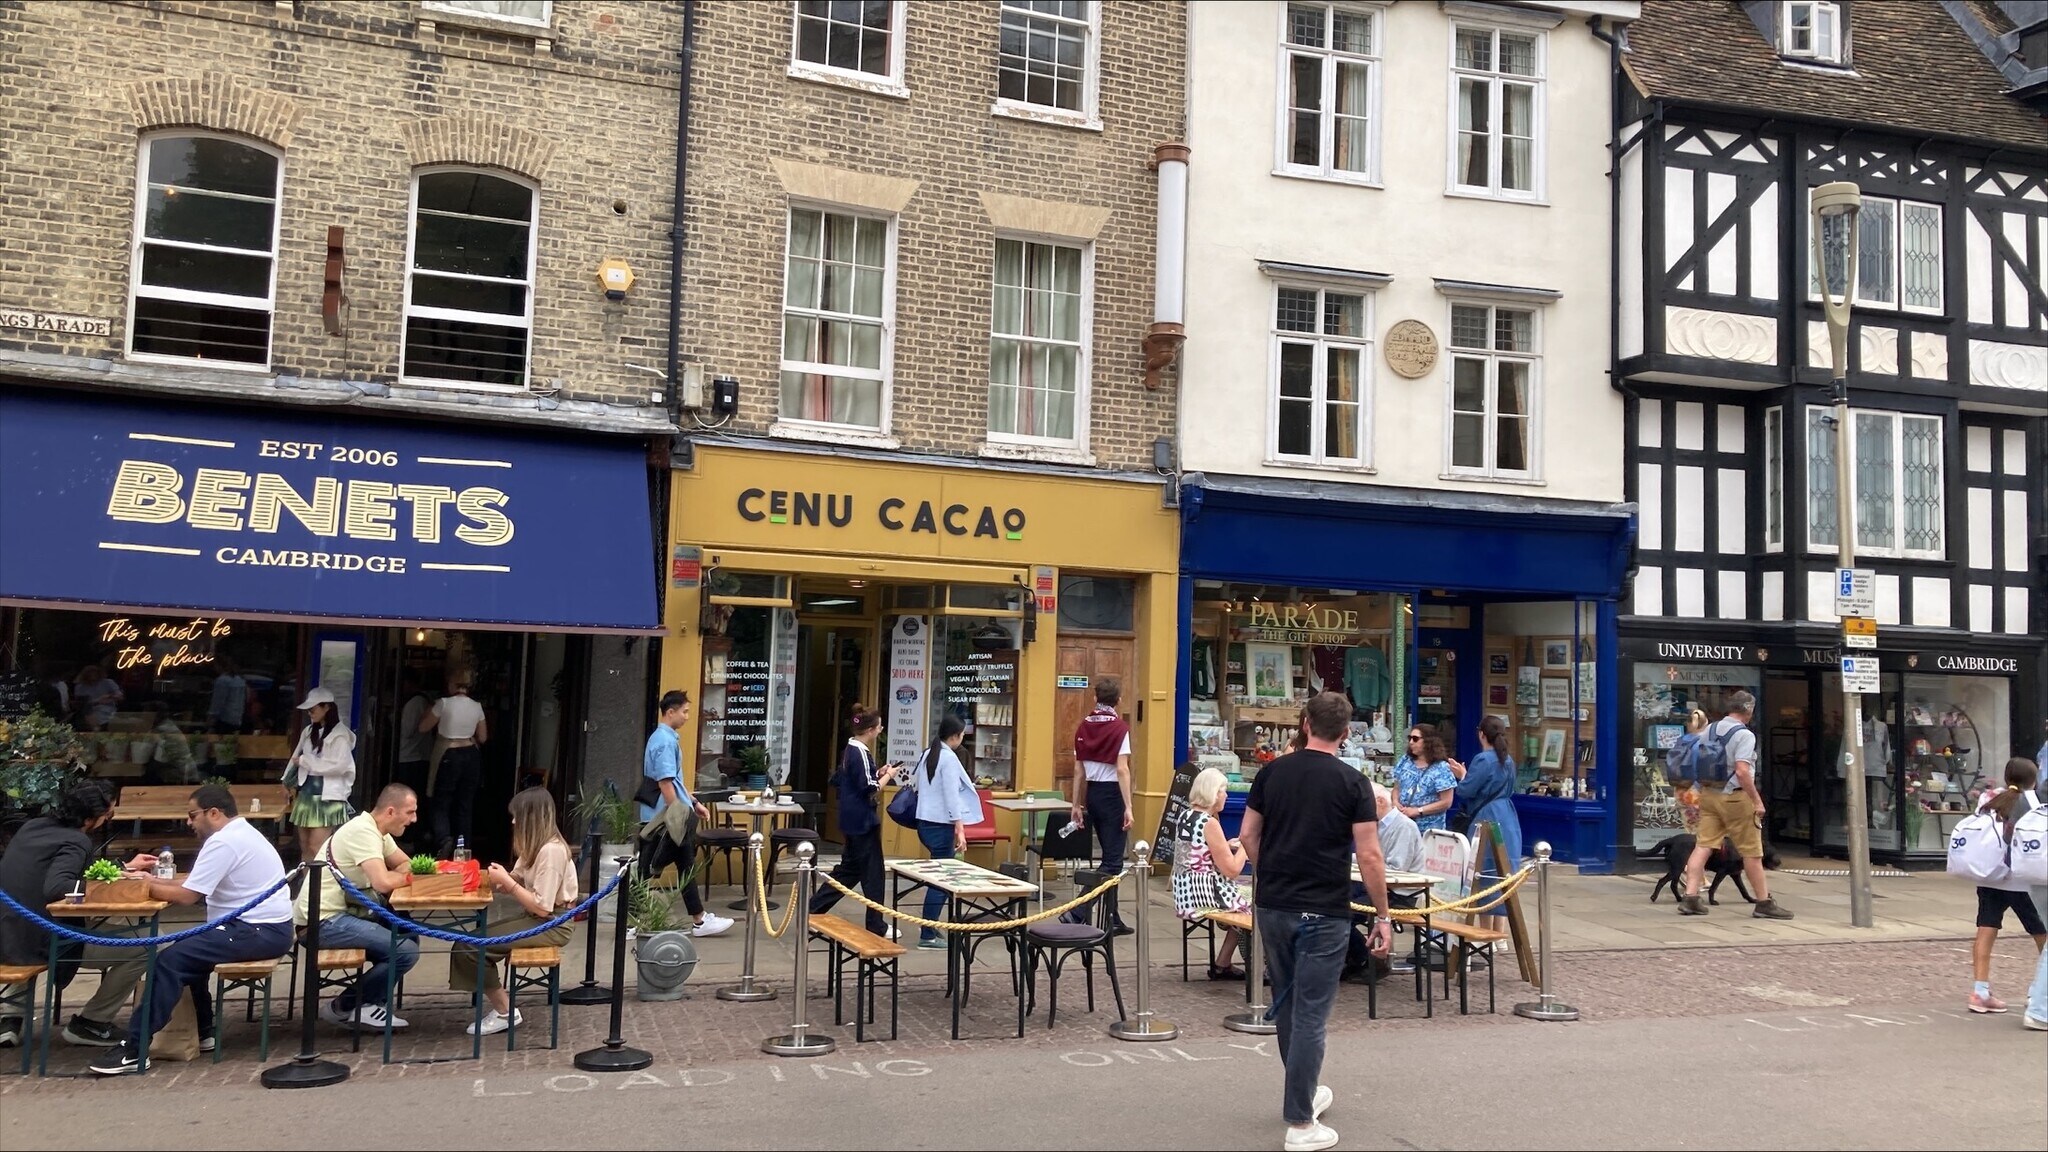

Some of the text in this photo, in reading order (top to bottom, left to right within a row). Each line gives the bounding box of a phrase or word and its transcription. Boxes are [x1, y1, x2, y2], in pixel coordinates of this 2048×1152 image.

[32, 313, 106, 334] PARADE
[259, 440, 399, 467] EST 2006
[106, 459, 516, 546] BENETS
[737, 488, 1026, 539] CENU CACAO
[215, 547, 407, 574] CAMBRIDGE
[99, 617, 232, 642] This must be
[1249, 602, 1359, 631] PARADE
[1261, 629, 1347, 643] THE GIFT SHOP
[117, 645, 215, 676] the place
[1658, 642, 1745, 660] UNIVERSITY
[1937, 655, 2018, 672] CAMBRIDGE
[908, 669, 924, 679] HERE
[1059, 1041, 1273, 1067] ONLY
[471, 1058, 934, 1098] LOADING
